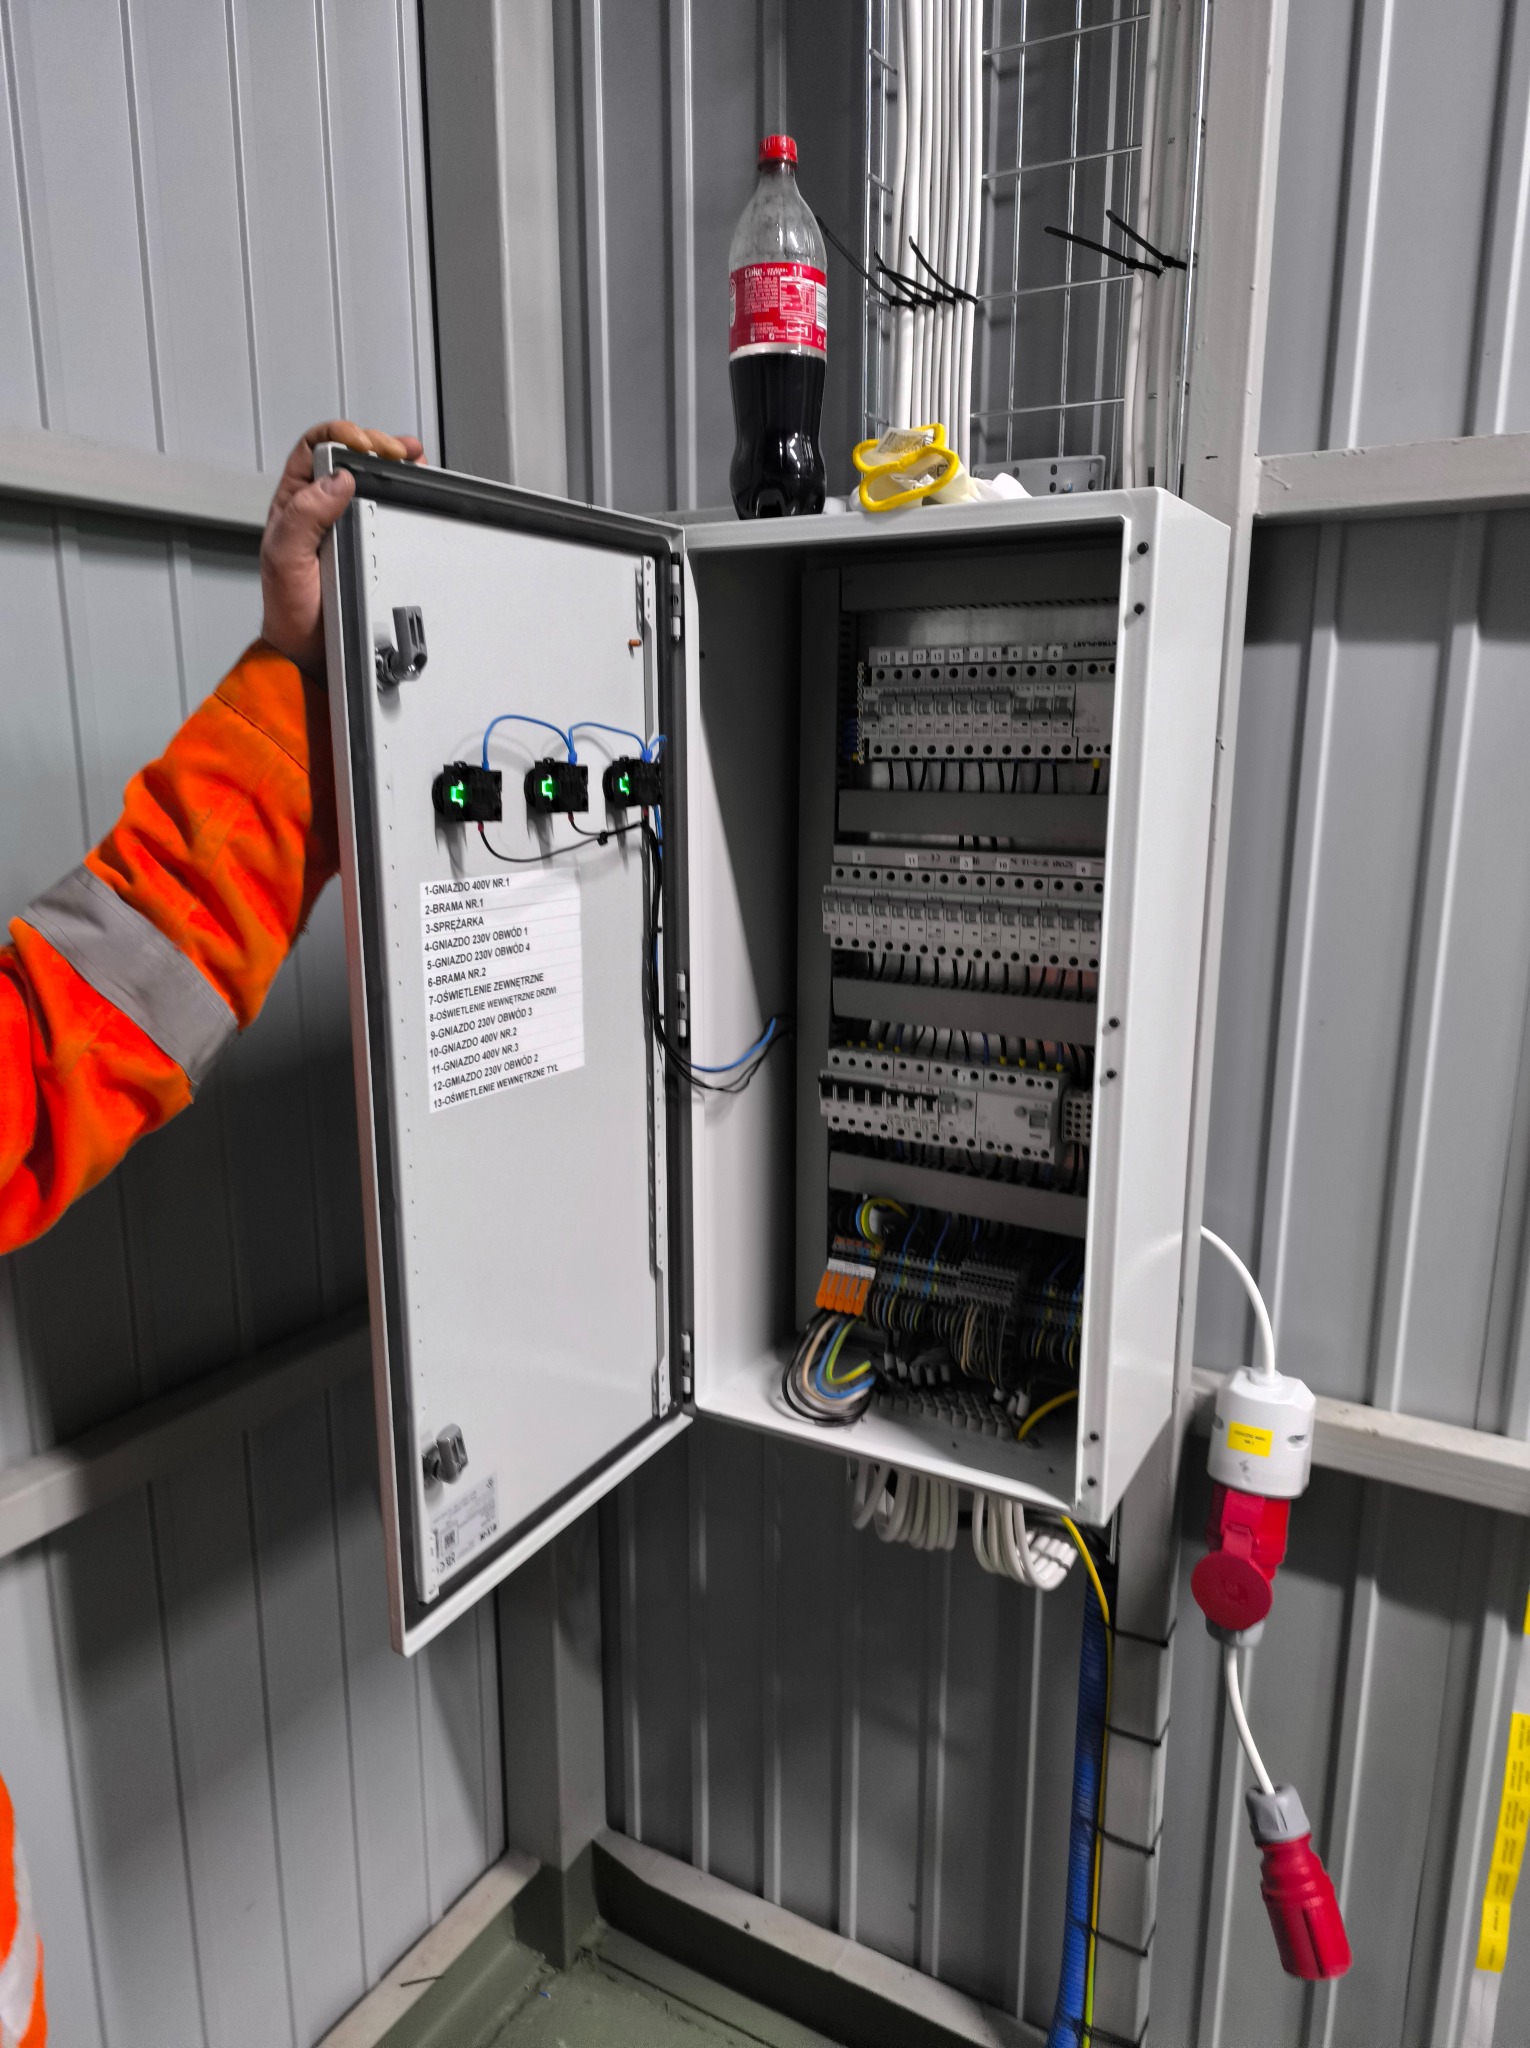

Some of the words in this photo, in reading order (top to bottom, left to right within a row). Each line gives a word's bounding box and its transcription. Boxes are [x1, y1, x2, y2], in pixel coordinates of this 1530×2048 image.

[425, 882, 470, 895] 1-GNIAZDO
[472, 879, 490, 889] 400V
[493, 878, 509, 888] NR.1
[425, 901, 463, 914] 2-BRAMA
[466, 898, 483, 908] NR.1
[426, 916, 484, 933] 3-SPRĘŻARKA
[424, 936, 470, 952] 4-GNIAZDO
[473, 932, 491, 944] 230V
[493, 926, 522, 940] OBWÓD
[524, 927, 528, 935] 1
[427, 953, 472, 970] 5-GNIAZDO
[475, 949, 493, 960] 230V
[495, 942, 524, 957] OBWÓD
[526, 943, 530, 951] 4
[428, 972, 465, 987] 6-BRAMA
[468, 968, 486, 978] NR.2
[429, 983, 492, 1005] 7-OŚWIETLENIE
[494, 973, 544, 991] ZEWNĘTRZNE
[430, 1002, 485, 1022] 8-OŚWIETLENIE
[487, 991, 534, 1009] WEWNĘTRZNE
[536, 986, 556, 996] DRZWI
[431, 1021, 475, 1040] 9-GNIAZDO
[478, 1016, 495, 1028] 230V
[498, 1009, 526, 1023] OBWÓD
[528, 1007, 532, 1016] 3
[430, 1037, 478, 1058] 10-GNIAZDO
[480, 1031, 498, 1044] 400V
[500, 1027, 517, 1038] NR.2
[432, 1053, 480, 1074] 11-GNIAZDO
[482, 1048, 500, 1060] 400V
[502, 1043, 519, 1054] NR.3
[485, 1064, 502, 1077] 230V
[504, 1055, 532, 1071] OBWÓD
[534, 1054, 538, 1062] 2
[434, 1082, 495, 1108] 13-OŚWIETLENIE
[497, 1068, 545, 1089] WEWNĘTRZNE
[547, 1064, 558, 1073] TYŁ
